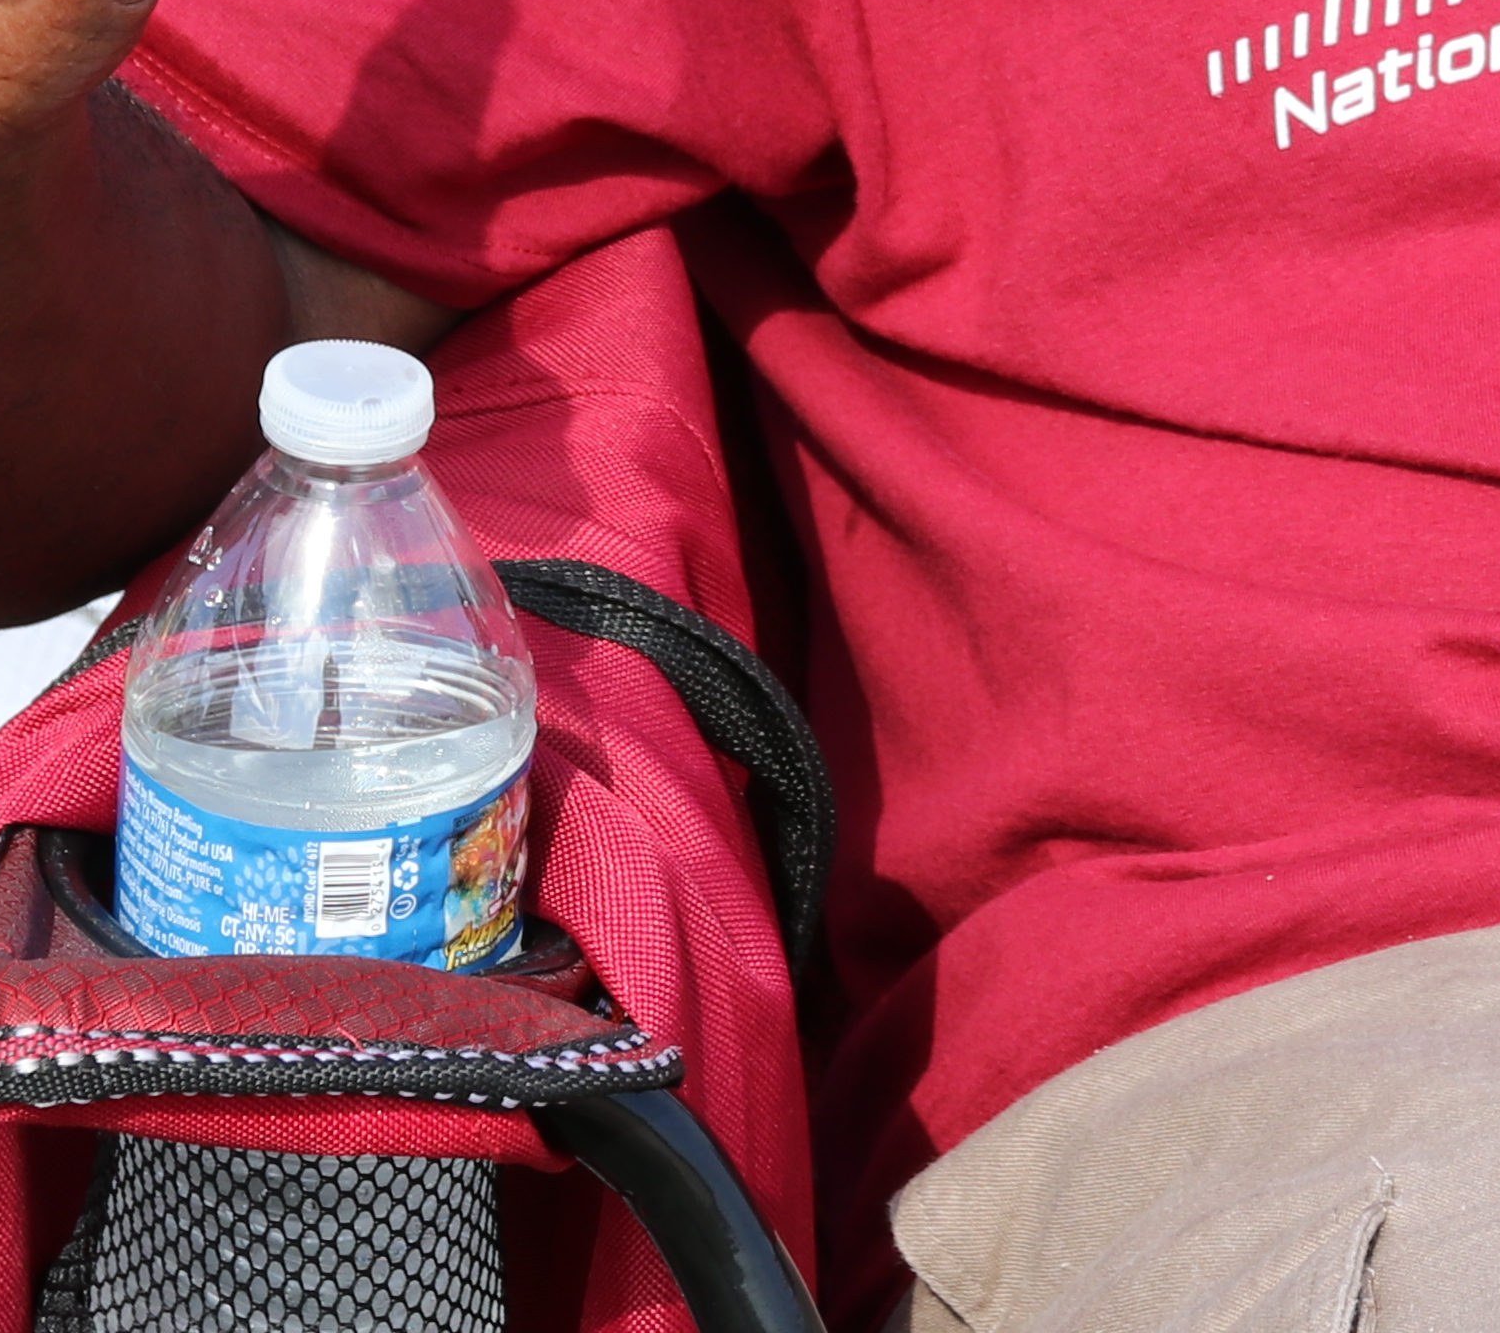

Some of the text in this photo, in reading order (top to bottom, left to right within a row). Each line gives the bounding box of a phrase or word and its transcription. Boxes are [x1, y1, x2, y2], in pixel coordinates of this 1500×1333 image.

[170, 824, 198, 851] Product
[199, 841, 210, 856] of
[210, 843, 234, 863] USA
[164, 840, 171, 857] &
[171, 845, 224, 881] information,
[169, 863, 212, 893] ITS-PURE
[213, 884, 224, 896] or
[166, 906, 201, 933] Osmosis
[220, 915, 272, 944] CT-NY:
[242, 901, 297, 925] HI-ME-
[141, 915, 154, 937] Cap
[168, 932, 209, 956] CHOKING
